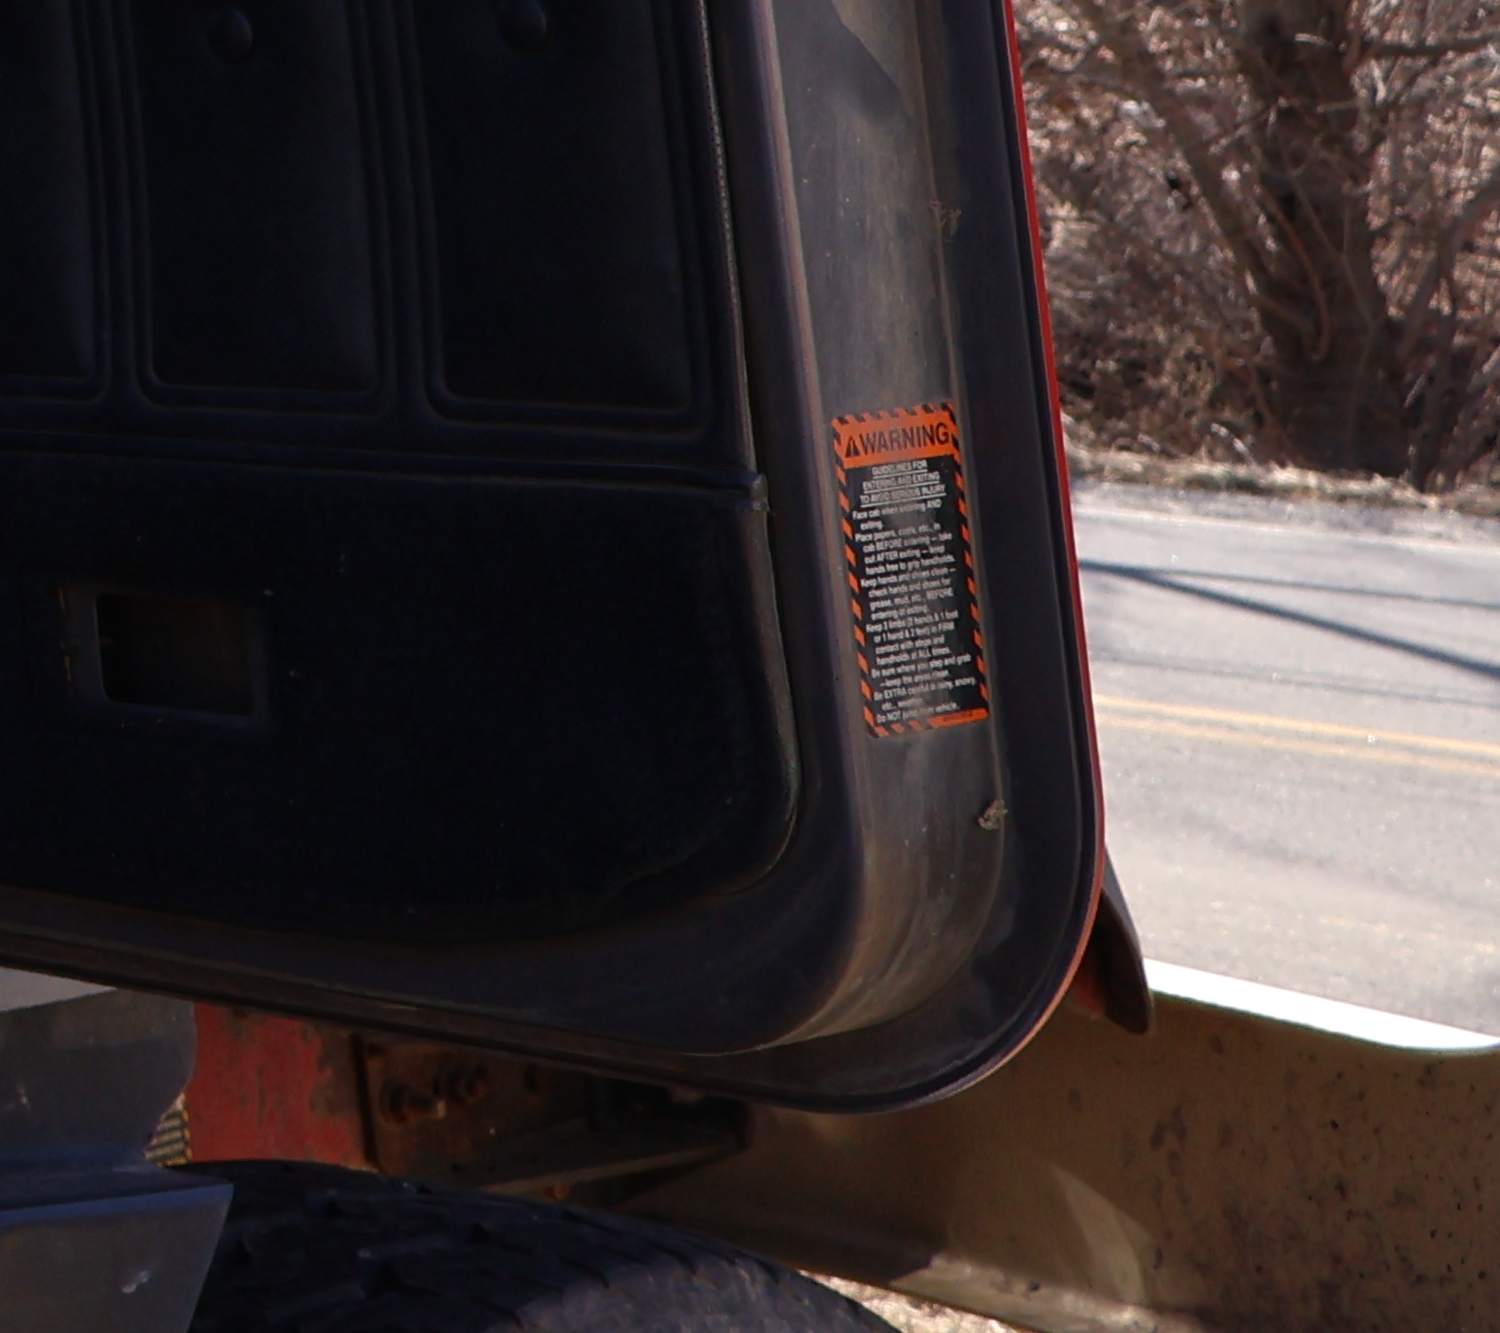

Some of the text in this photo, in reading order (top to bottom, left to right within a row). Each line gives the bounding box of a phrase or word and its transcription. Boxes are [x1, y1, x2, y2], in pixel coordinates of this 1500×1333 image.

[859, 422, 949, 455] WARNING
[912, 459, 927, 471] FOR
[852, 511, 868, 520] Face
[927, 499, 942, 508] AND
[876, 538, 902, 551] BEFORE
[877, 550, 898, 561] AFTER
[860, 578, 877, 589] Keep
[866, 623, 882, 633] Keep
[918, 648, 931, 659] ALL
[956, 653, 972, 666] grab
[884, 687, 907, 699] EXTRA
[877, 713, 886, 723] Do
[886, 711, 902, 721] NOT
